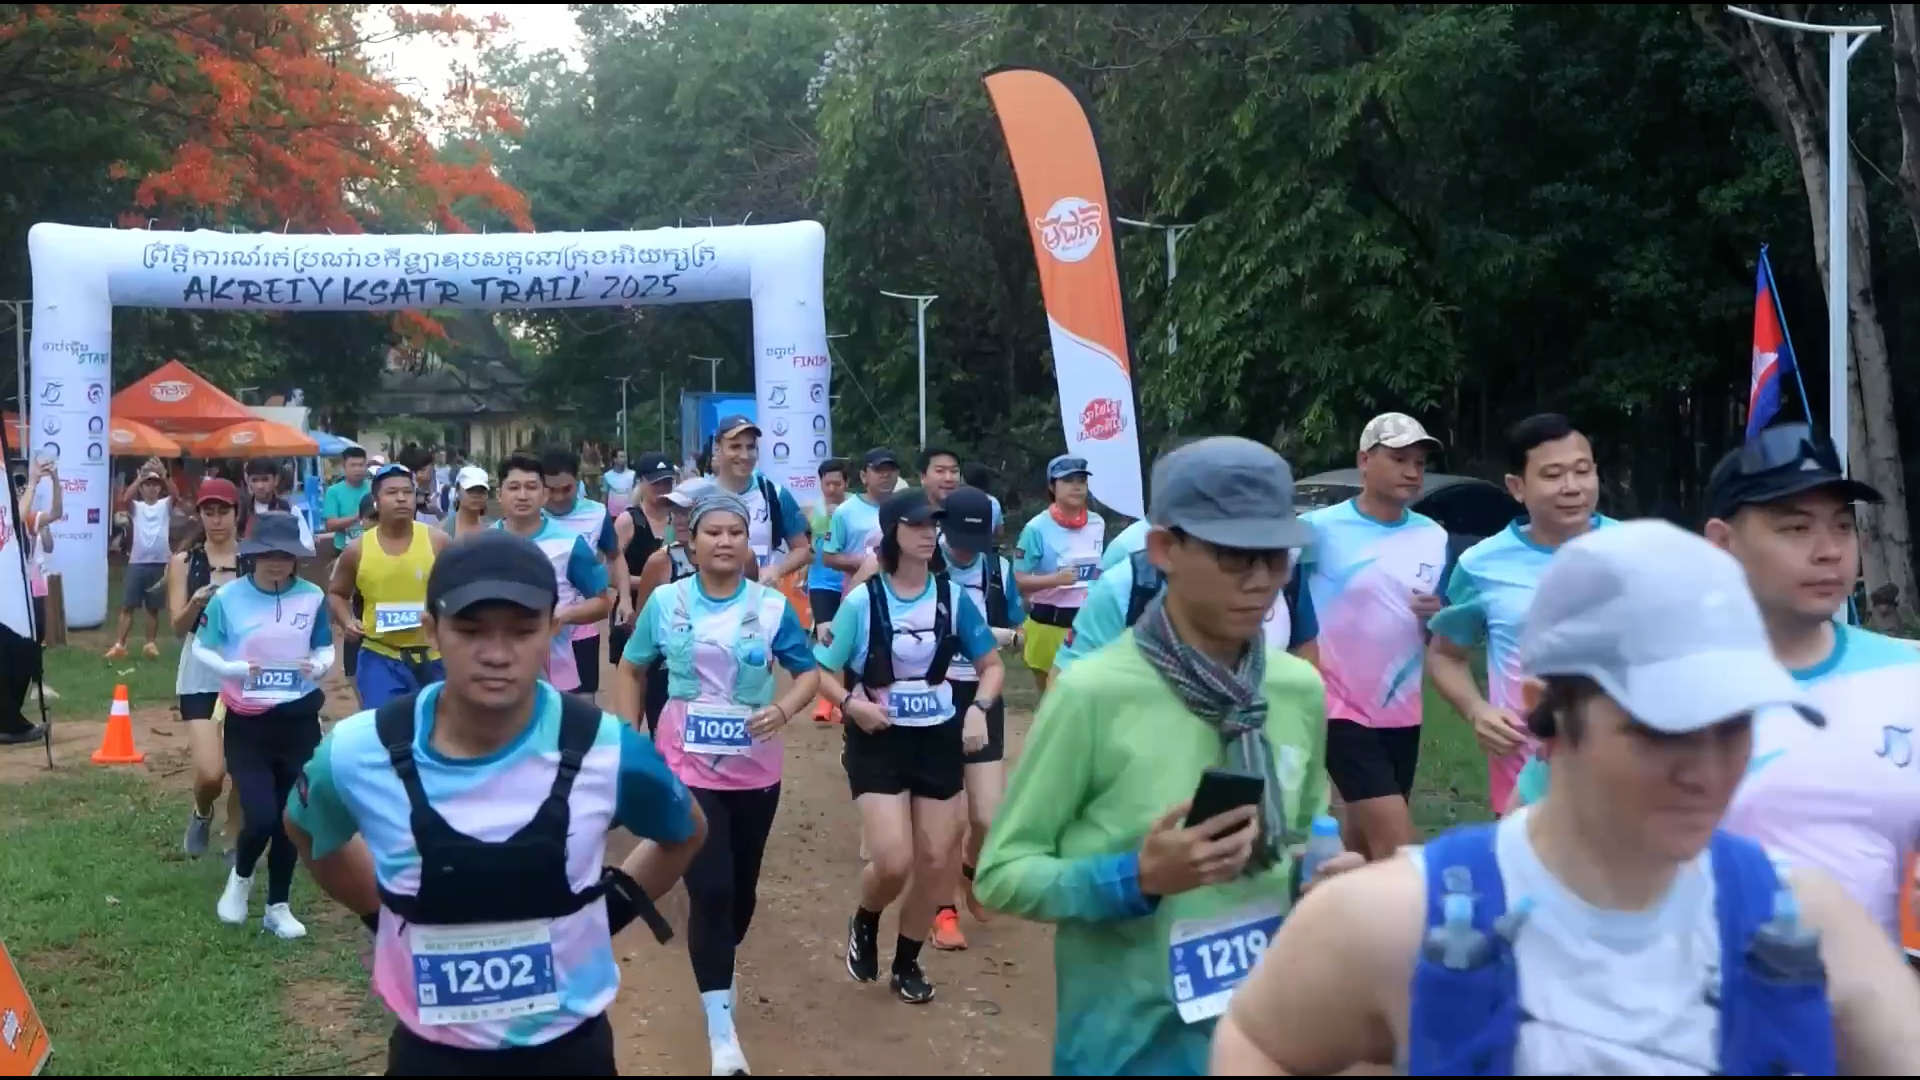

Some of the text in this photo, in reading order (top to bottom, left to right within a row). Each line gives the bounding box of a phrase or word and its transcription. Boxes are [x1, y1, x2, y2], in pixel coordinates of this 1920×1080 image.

[183, 274, 680, 305] AKREIY KSATR TRAIL 2025
[256, 672, 293, 686] 1025
[698, 720, 744, 739] 1002
[1196, 929, 1268, 979] 1219
[440, 953, 535, 994] 1202
